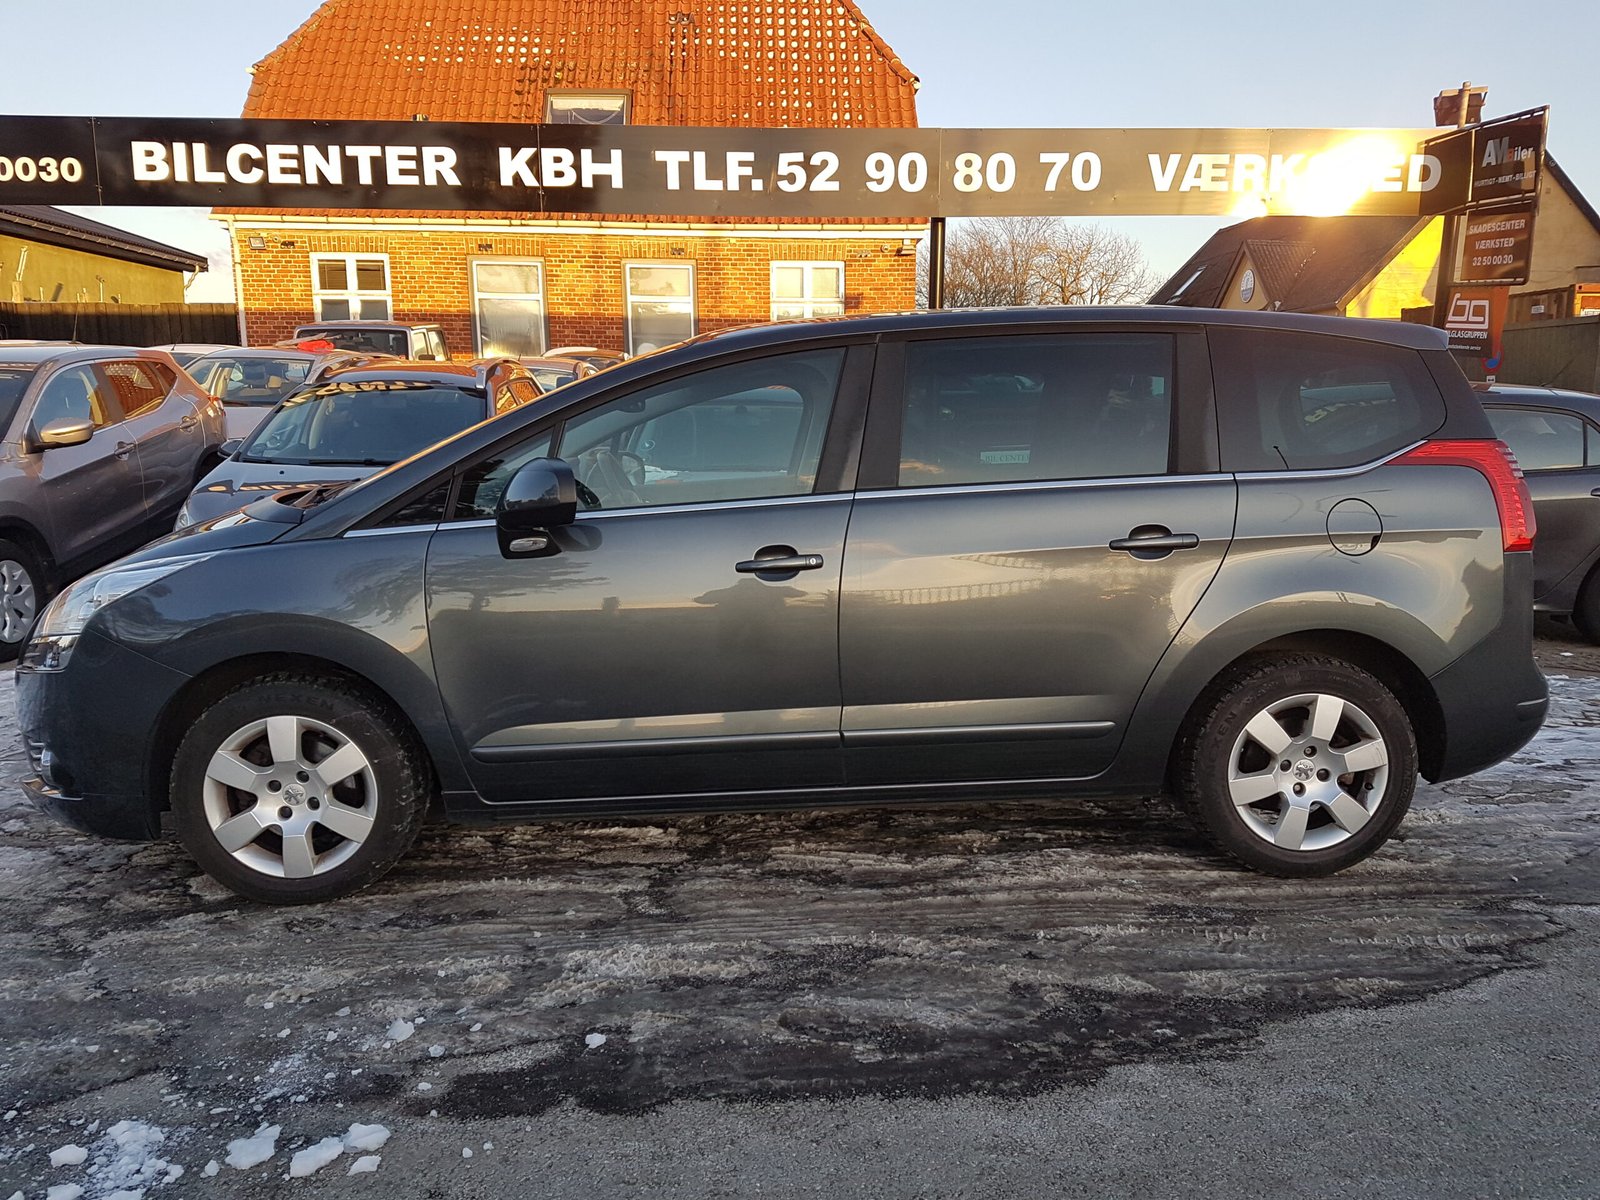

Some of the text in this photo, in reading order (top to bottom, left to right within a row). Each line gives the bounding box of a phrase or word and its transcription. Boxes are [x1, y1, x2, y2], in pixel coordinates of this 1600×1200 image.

[0, 156, 82, 182] 0030
[131, 141, 1441, 193] BILCENTER KBH TLF. 52 90 80 70 VÆRKED
[1469, 219, 1525, 234] SKADESCENTER
[1475, 237, 1515, 250] VÆRKSTED
